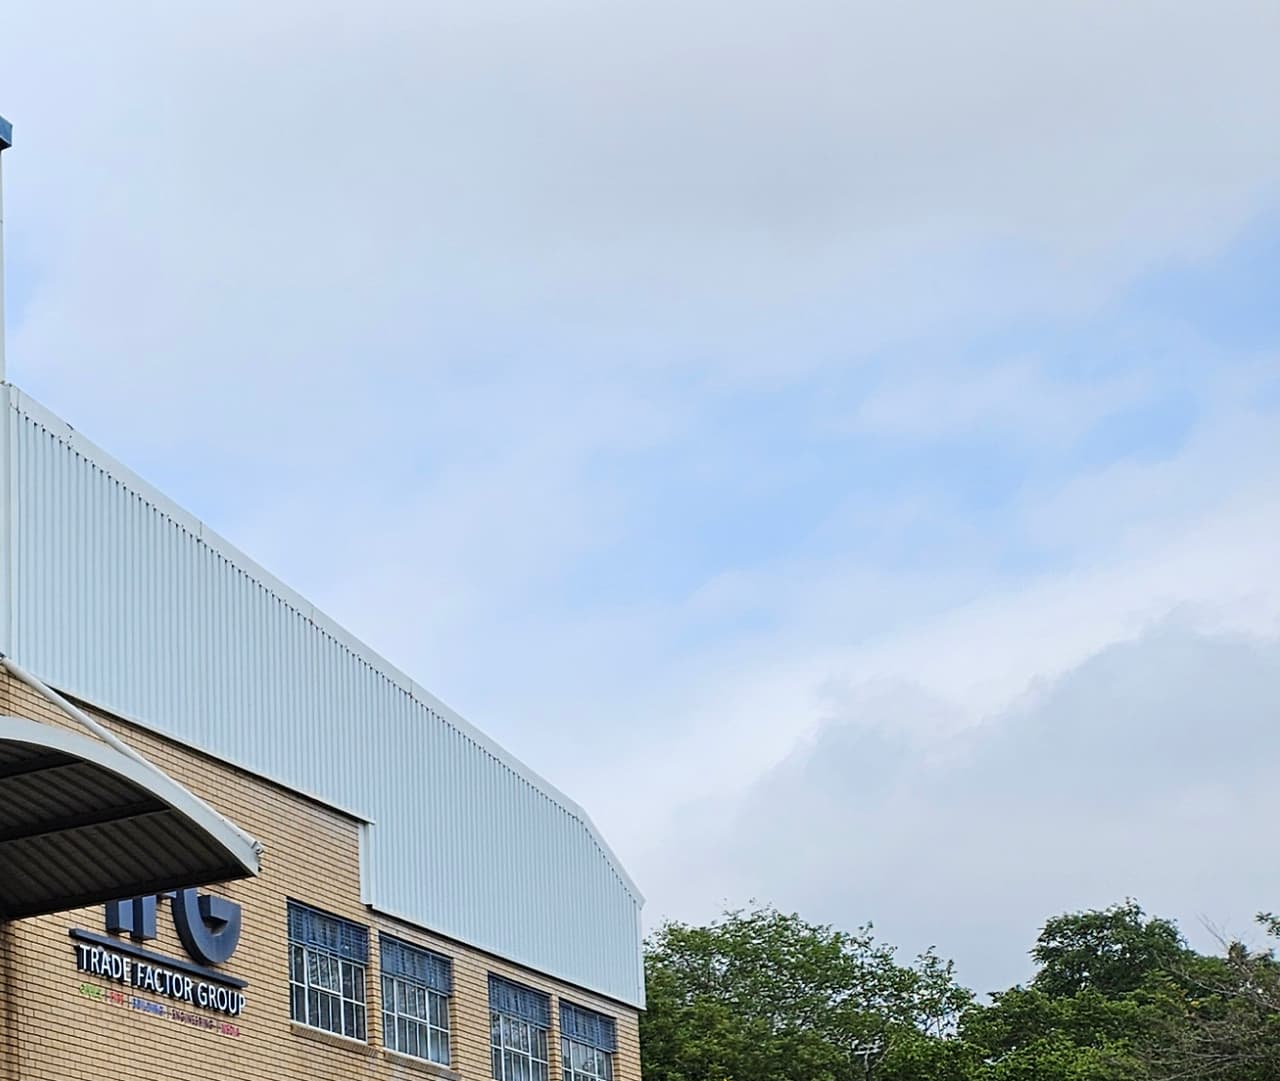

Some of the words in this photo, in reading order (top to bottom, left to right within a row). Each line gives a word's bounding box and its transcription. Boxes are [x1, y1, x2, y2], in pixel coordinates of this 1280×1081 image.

[80, 944, 132, 983] TRADE
[137, 962, 193, 1001] FACTOR
[197, 982, 247, 1017] GROUP
